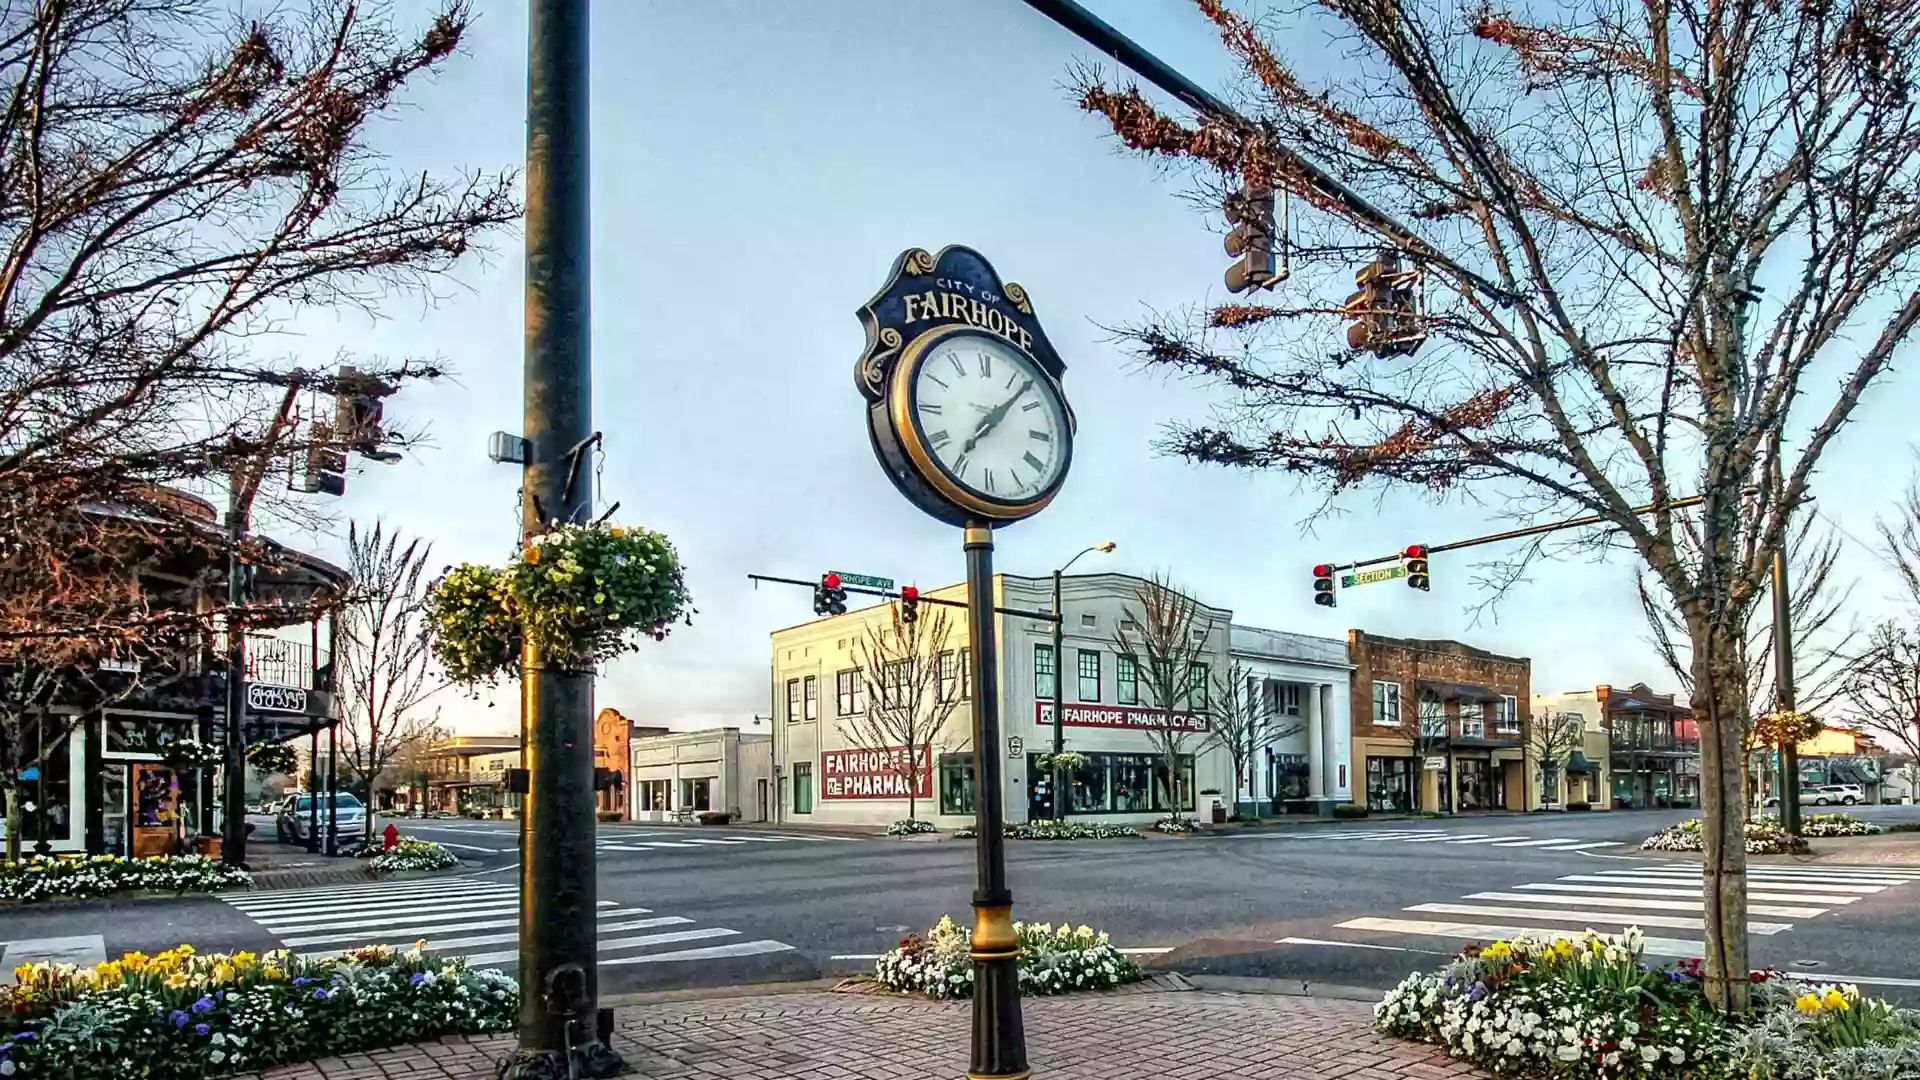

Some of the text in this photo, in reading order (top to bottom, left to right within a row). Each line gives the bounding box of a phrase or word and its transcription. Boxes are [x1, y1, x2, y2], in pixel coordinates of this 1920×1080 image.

[936, 278, 1001, 304] CITY OF
[903, 290, 1034, 350] FAIRHOPE
[876, 579, 894, 589] AVE
[1355, 568, 1392, 585] SECTION
[1064, 708, 1123, 724] FAIRHOPE
[826, 751, 900, 773] FAIRHOPE
